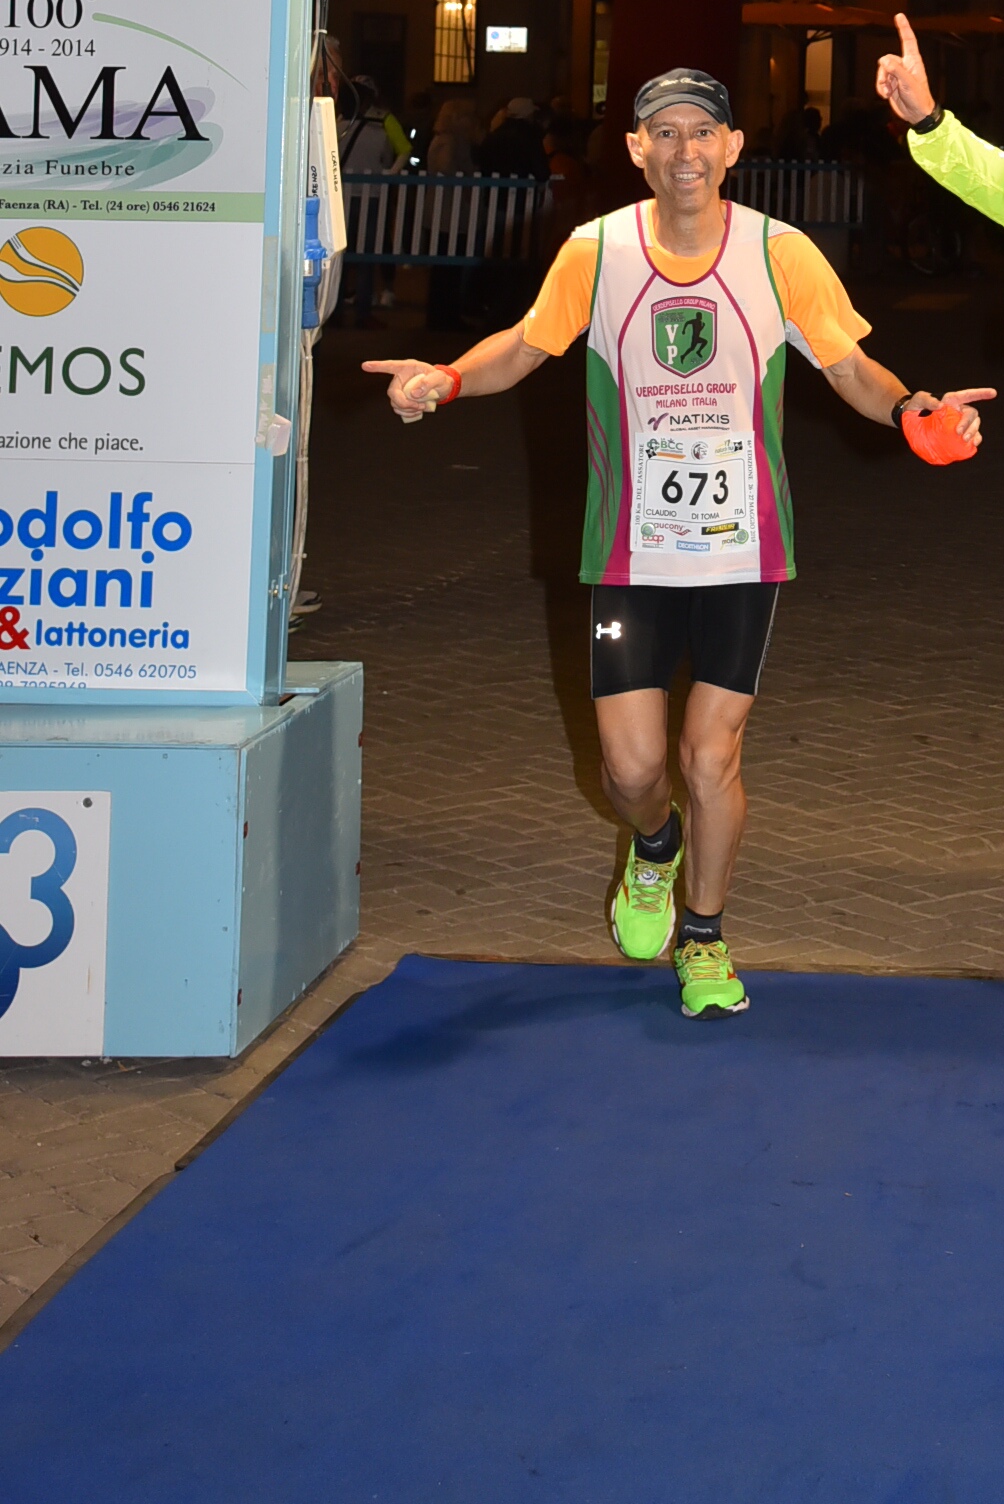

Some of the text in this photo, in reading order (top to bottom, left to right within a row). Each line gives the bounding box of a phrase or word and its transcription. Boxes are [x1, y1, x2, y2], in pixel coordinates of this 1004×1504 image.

[50, 39, 96, 58] 2014
[3, 159, 136, 178] zia Funebre
[43, 199, 216, 214] (RA) Tel. (24 ore) 0546 21624
[635, 382, 737, 398] VERDEPISELLO GROUP
[655, 397, 718, 408] MILANO ITALIA
[669, 413, 730, 426] NATIXIS
[58, 430, 144, 458] che piace.
[661, 469, 730, 506] 673
[646, 508, 745, 521] CLAUDIO DI TOMA ITA
[35, 618, 190, 650] lattoneria
[65, 662, 197, 679] Tel. 0546 620705
